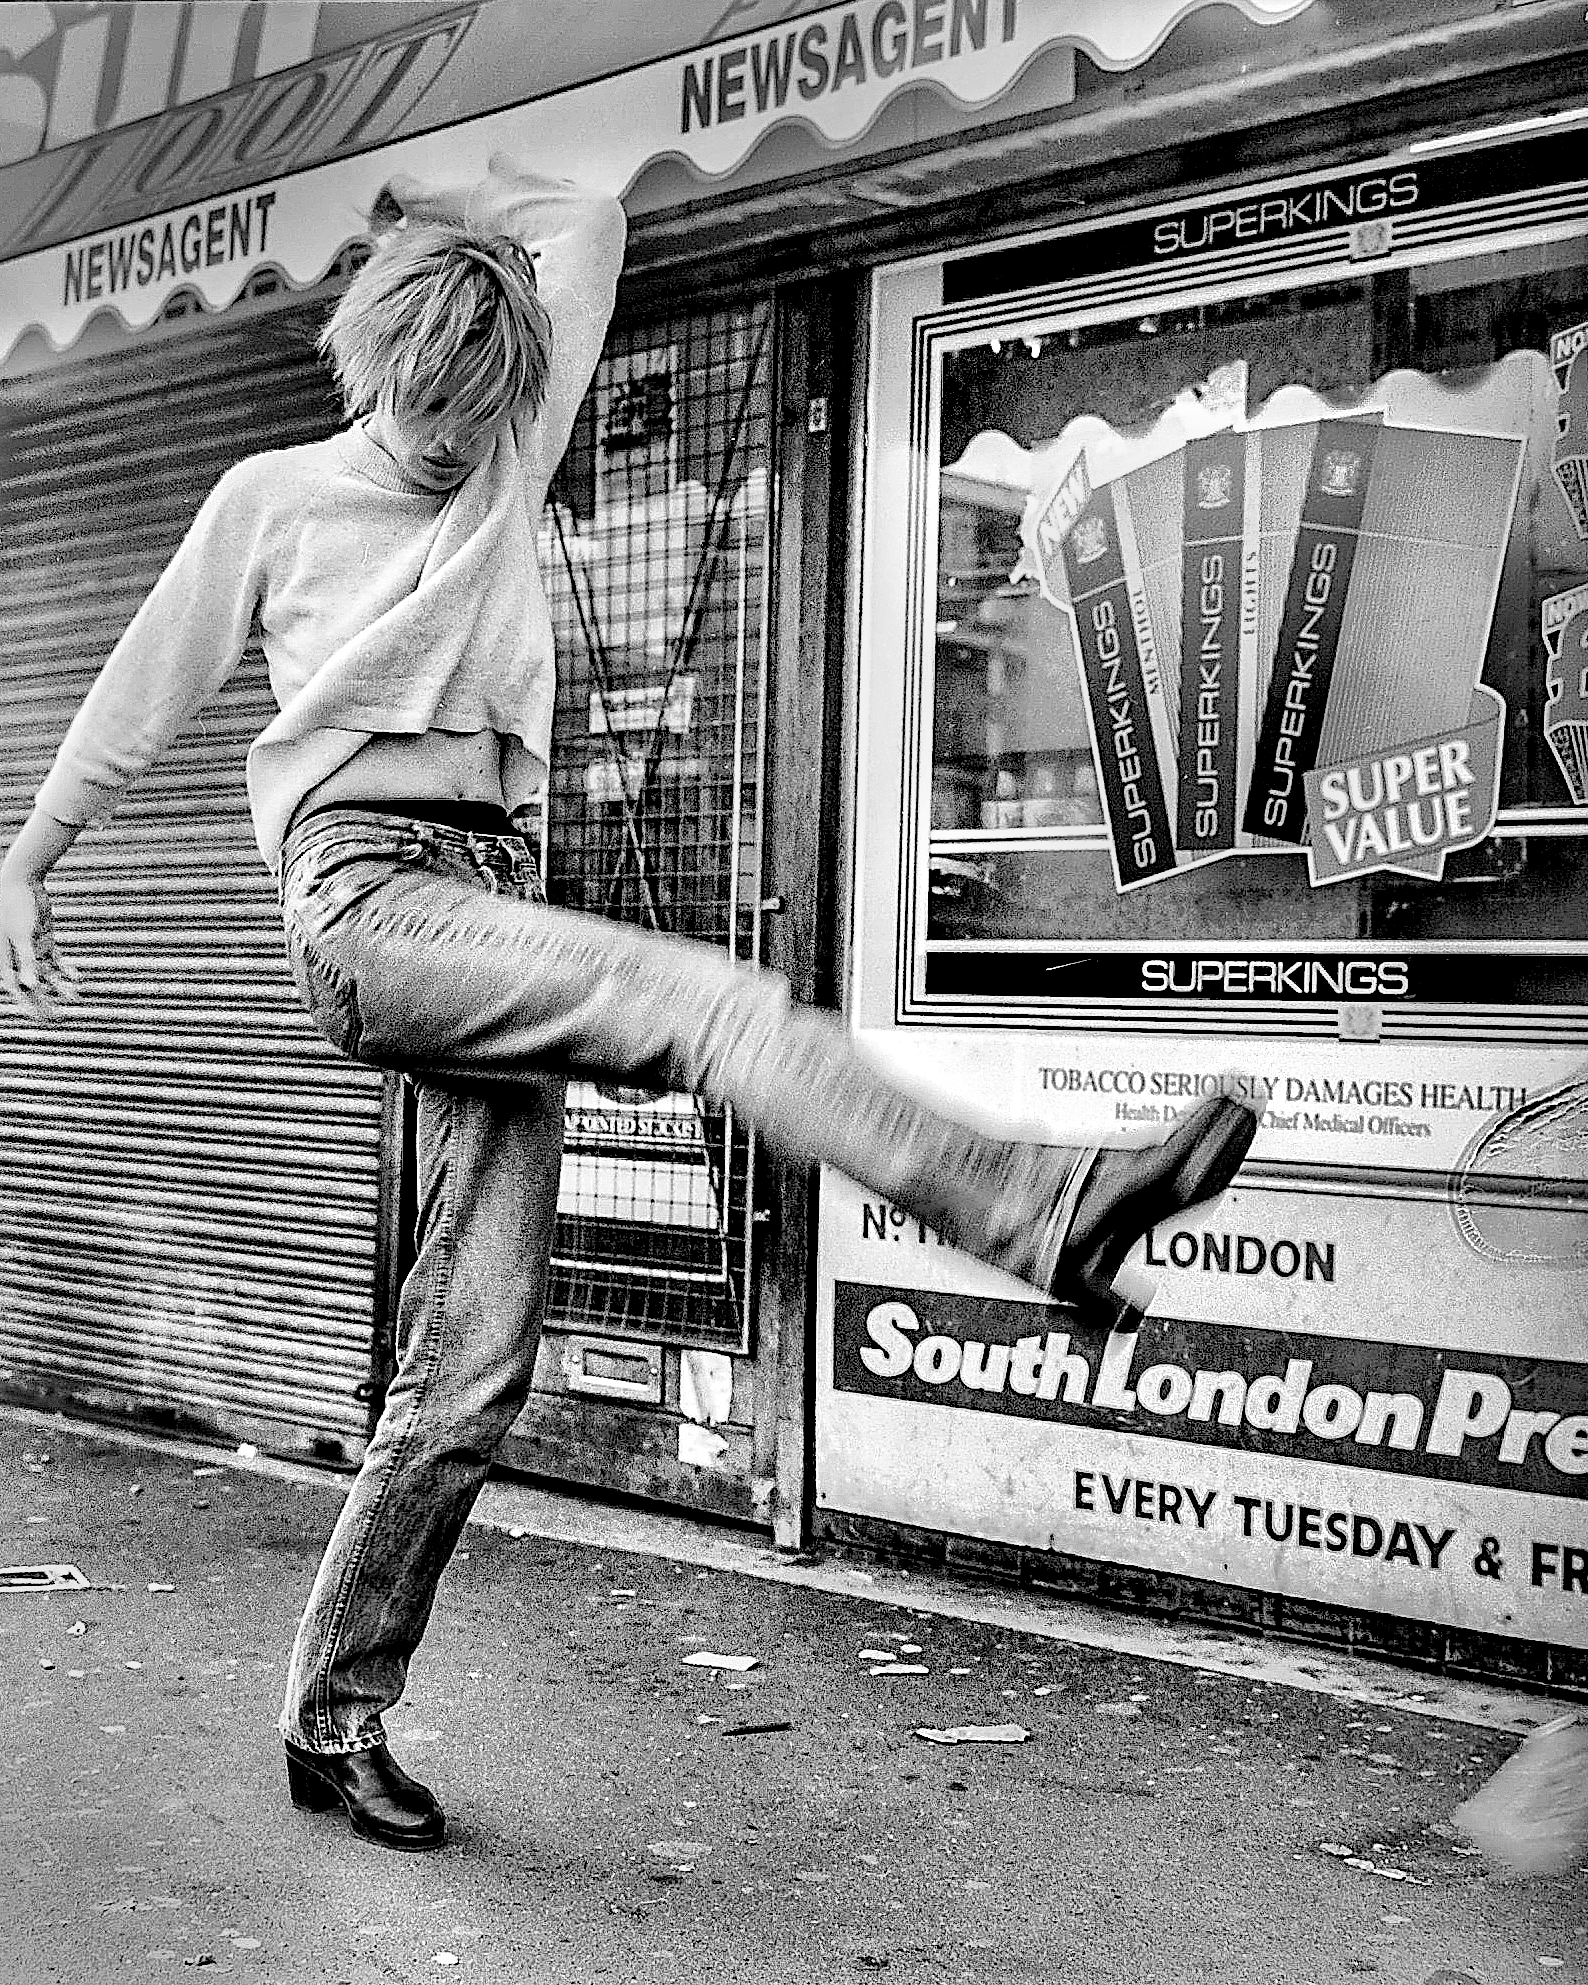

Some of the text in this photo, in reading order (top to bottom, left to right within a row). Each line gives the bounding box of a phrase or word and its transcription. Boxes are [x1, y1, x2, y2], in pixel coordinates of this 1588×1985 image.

[63, 191, 276, 306] NEWSAGENT
[1153, 172, 1420, 254] SUPERKINGS
[1195, 553, 1225, 838] SUPERKINGS
[1263, 541, 1338, 827] SUPERKINGS
[1092, 599, 1158, 869] SUPERKINGS
[1321, 739, 1474, 820] SUPER
[1324, 788, 1474, 867] VALUE
[1141, 959, 1409, 996] SUPERKINGS
[1038, 1066, 1527, 1112] TOBACCO SERIOUSLY DAMAGES HEALTH
[1115, 1101, 1160, 1121] Health
[1302, 1112, 1364, 1134] Medical
[1367, 1115, 1432, 1138] Officers
[1144, 1228, 1336, 1282] LONDON
[1074, 1471, 1588, 1595] EVERY TUESDAY & FR
